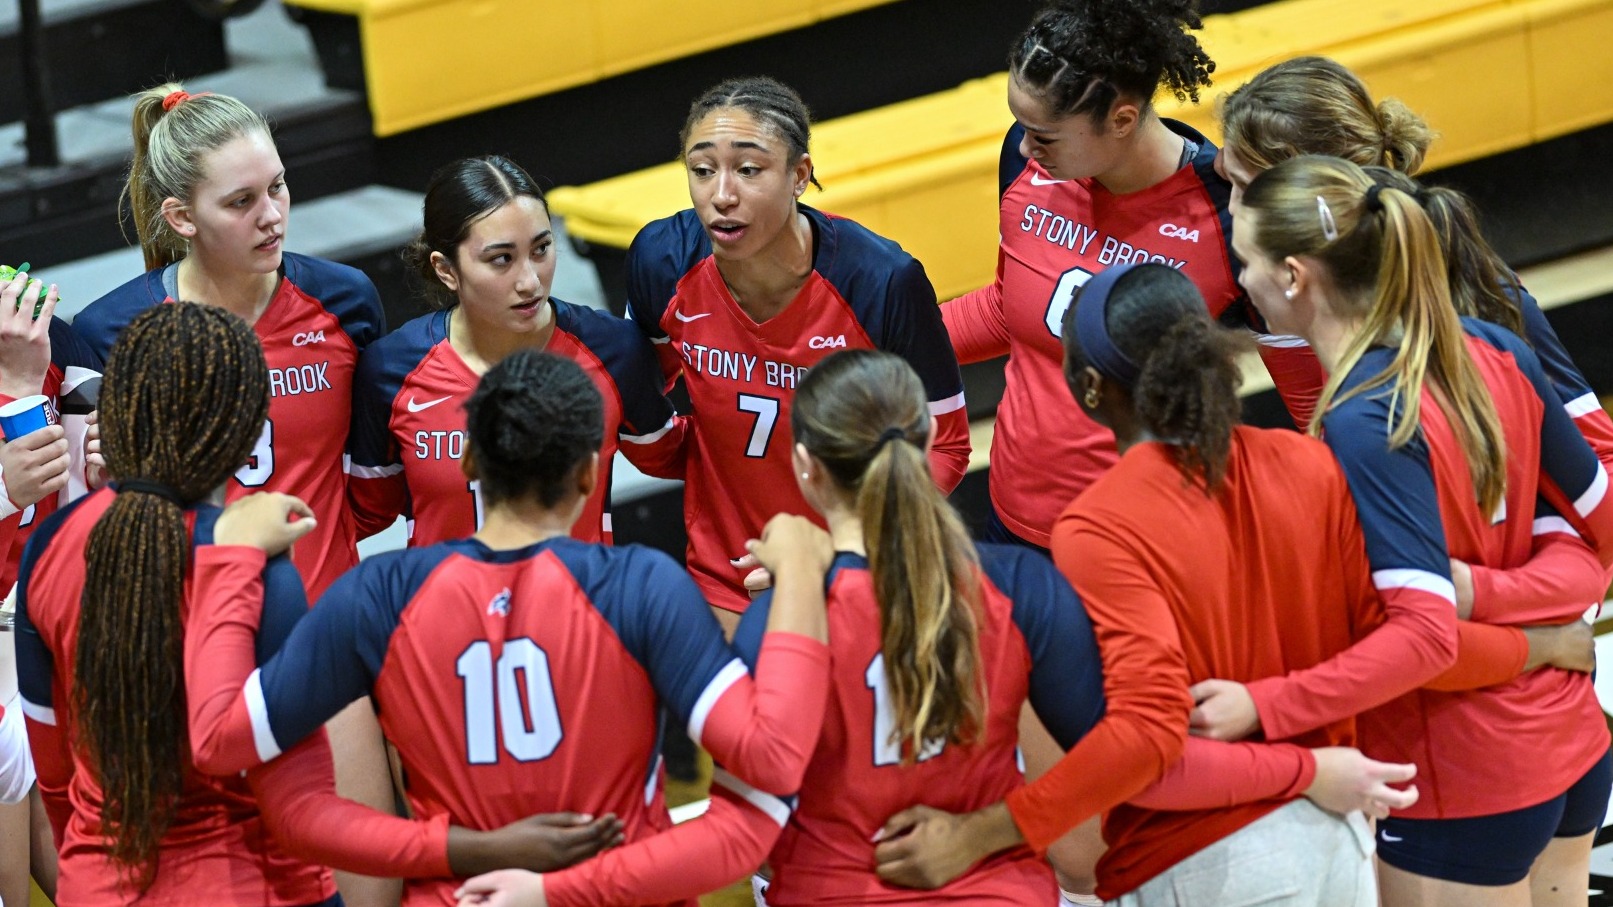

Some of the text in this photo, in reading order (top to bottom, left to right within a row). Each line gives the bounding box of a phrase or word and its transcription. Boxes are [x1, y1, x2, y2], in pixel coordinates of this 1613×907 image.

[1020, 203, 1098, 255] STONY
[1158, 223, 1200, 243] CAA
[291, 330, 327, 347] CAA
[808, 334, 847, 349] CAA
[268, 361, 332, 397] ROOK
[682, 341, 757, 382] STONY
[736, 391, 780, 459] 7
[415, 429, 470, 460] STO
[456, 636, 565, 766] 10
